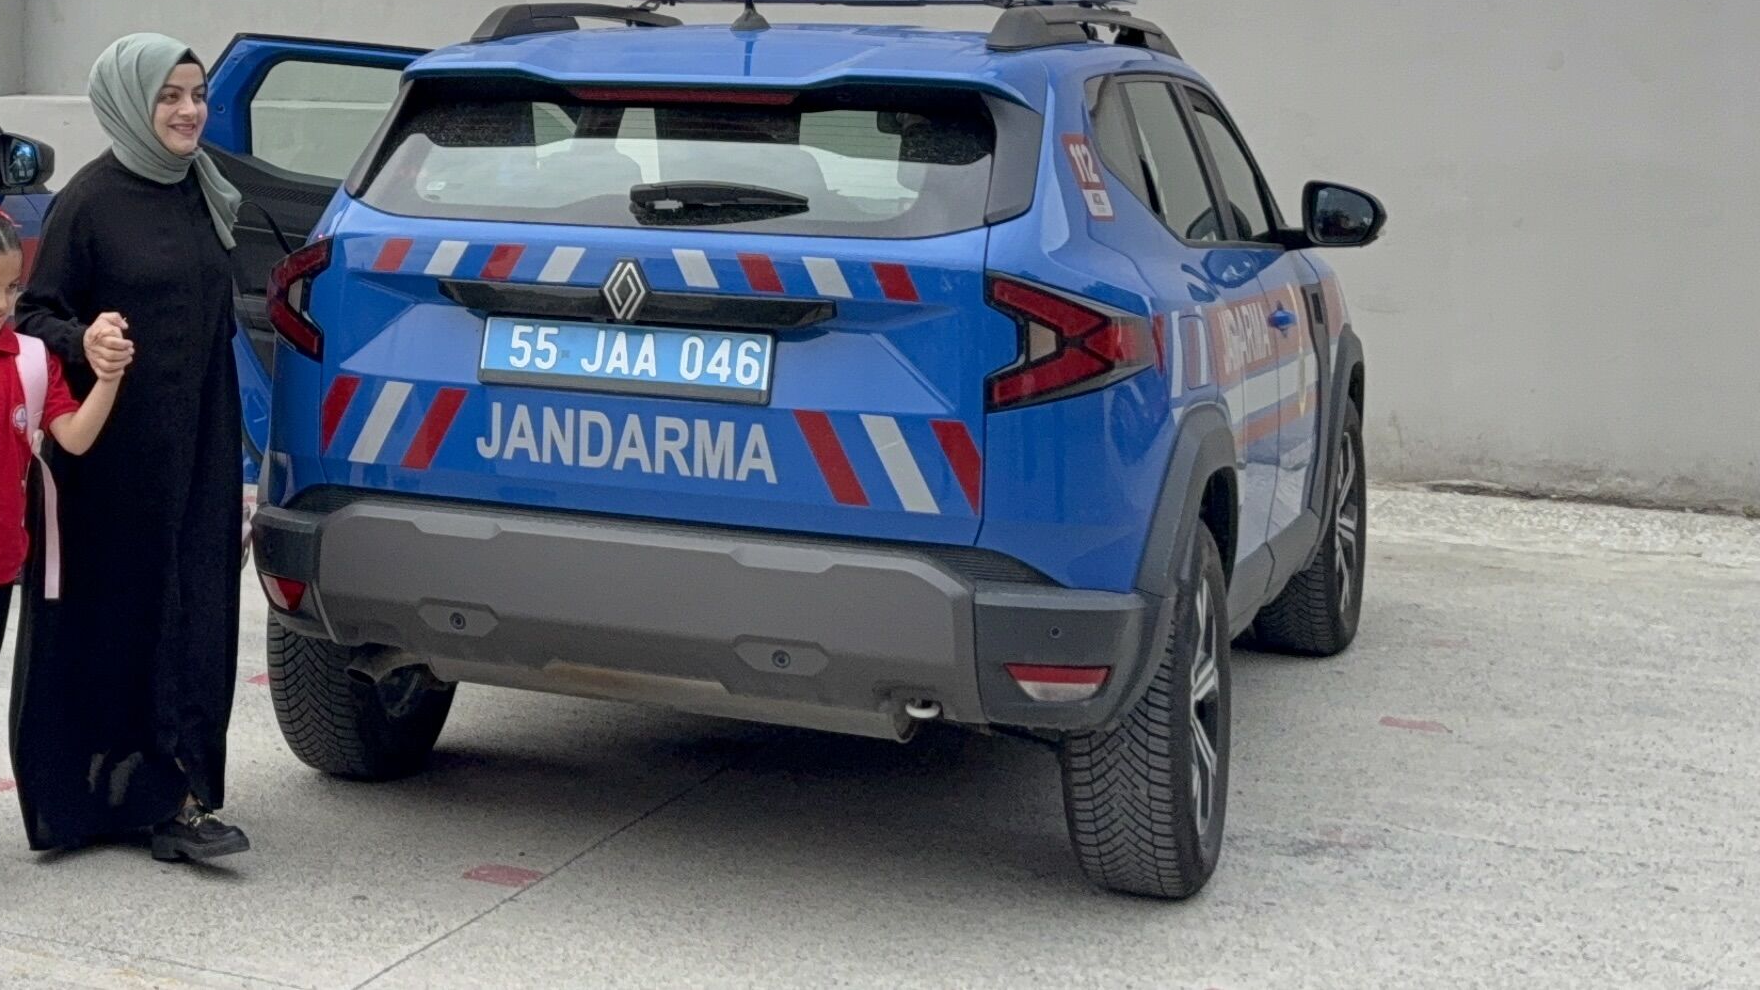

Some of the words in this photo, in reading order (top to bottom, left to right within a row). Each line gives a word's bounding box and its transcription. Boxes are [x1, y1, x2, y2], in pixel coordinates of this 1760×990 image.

[1069, 143, 1100, 183] 112
[509, 324, 560, 370] 55
[580, 330, 657, 378] JAA
[679, 336, 762, 386] 046
[476, 401, 778, 485] JANDARMA
